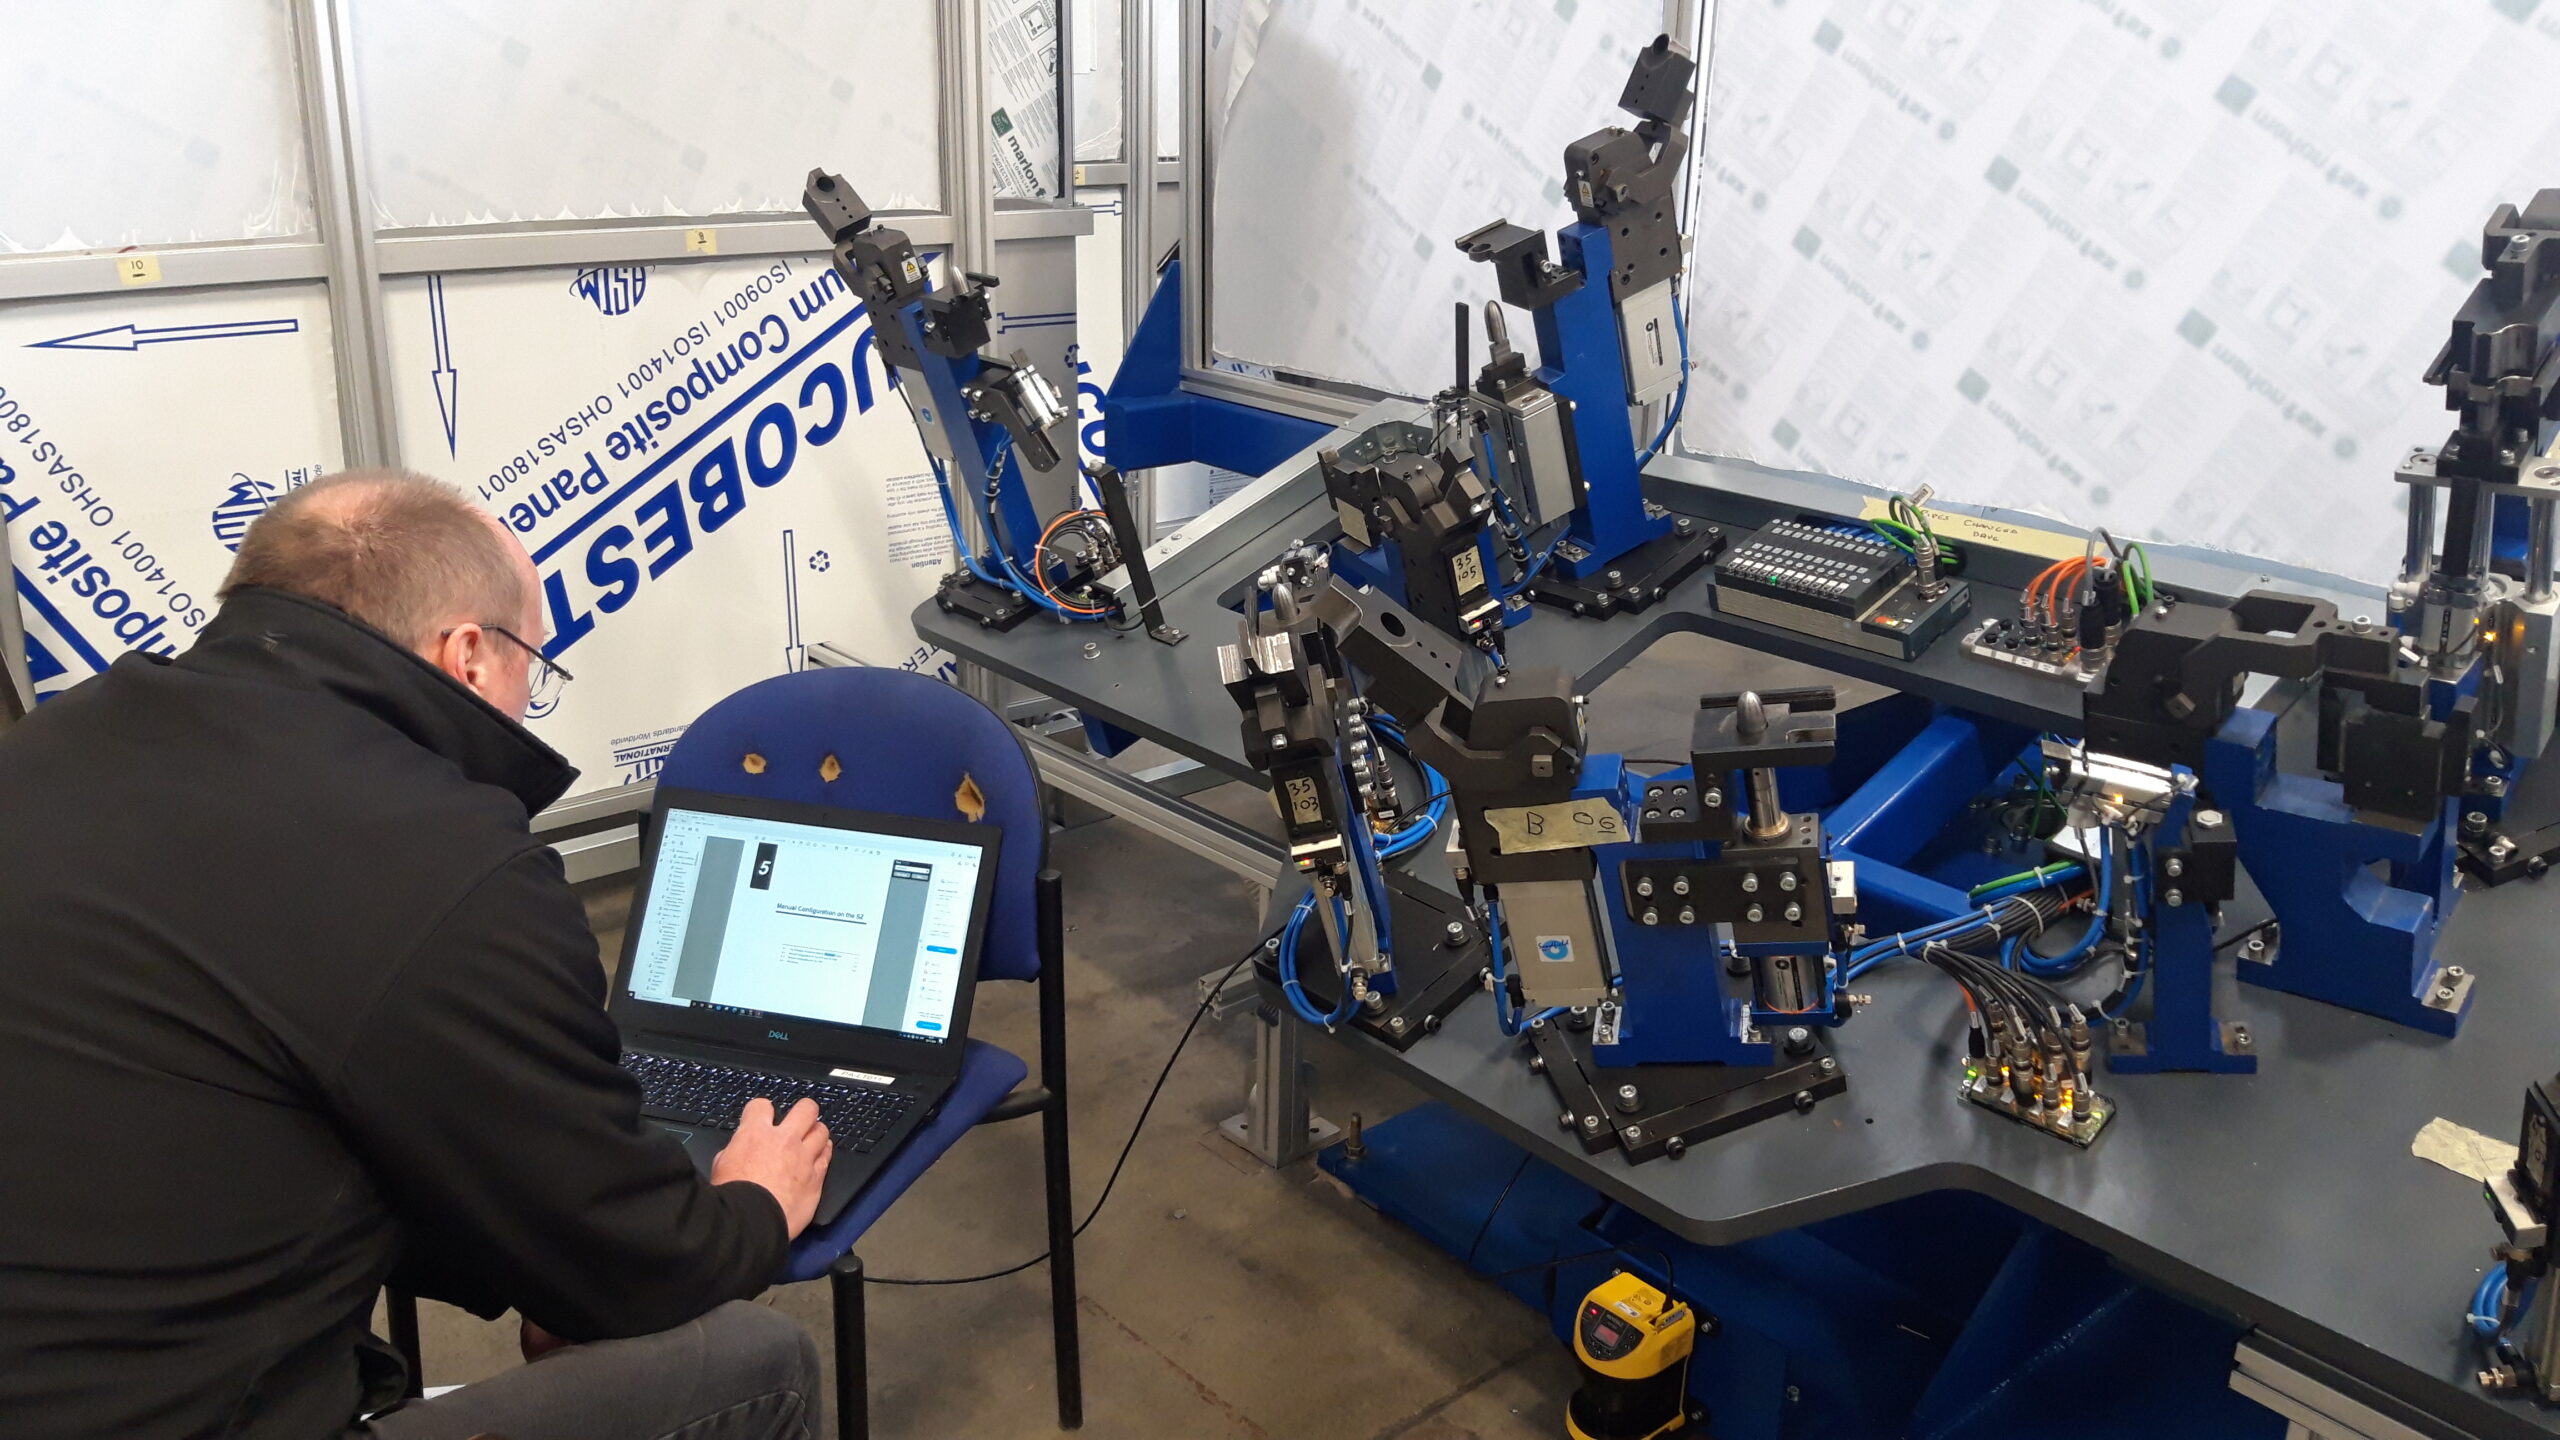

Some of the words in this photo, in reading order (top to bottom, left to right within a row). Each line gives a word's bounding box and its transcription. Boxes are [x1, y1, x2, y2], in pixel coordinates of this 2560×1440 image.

[1007, 135, 1039, 189] marlon
[131, 260, 144, 270] 10
[714, 259, 794, 325] ISO9001
[617, 321, 707, 398] ISO14001
[606, 314, 789, 461] Composite
[476, 395, 612, 502] OHSAS18001
[1456, 553, 1472, 569] 35
[111, 528, 207, 635] SO14001
[1458, 565, 1478, 582] 105
[610, 732, 651, 746] Worldwide
[1288, 780, 1311, 794] 35
[1290, 796, 1319, 812] 103
[1527, 811, 1544, 836] B
[757, 860, 772, 876] 5
[777, 902, 797, 912] Manual
[797, 904, 836, 917] Configuration
[845, 910, 855, 918] the
[768, 1030, 789, 1041] DELL
